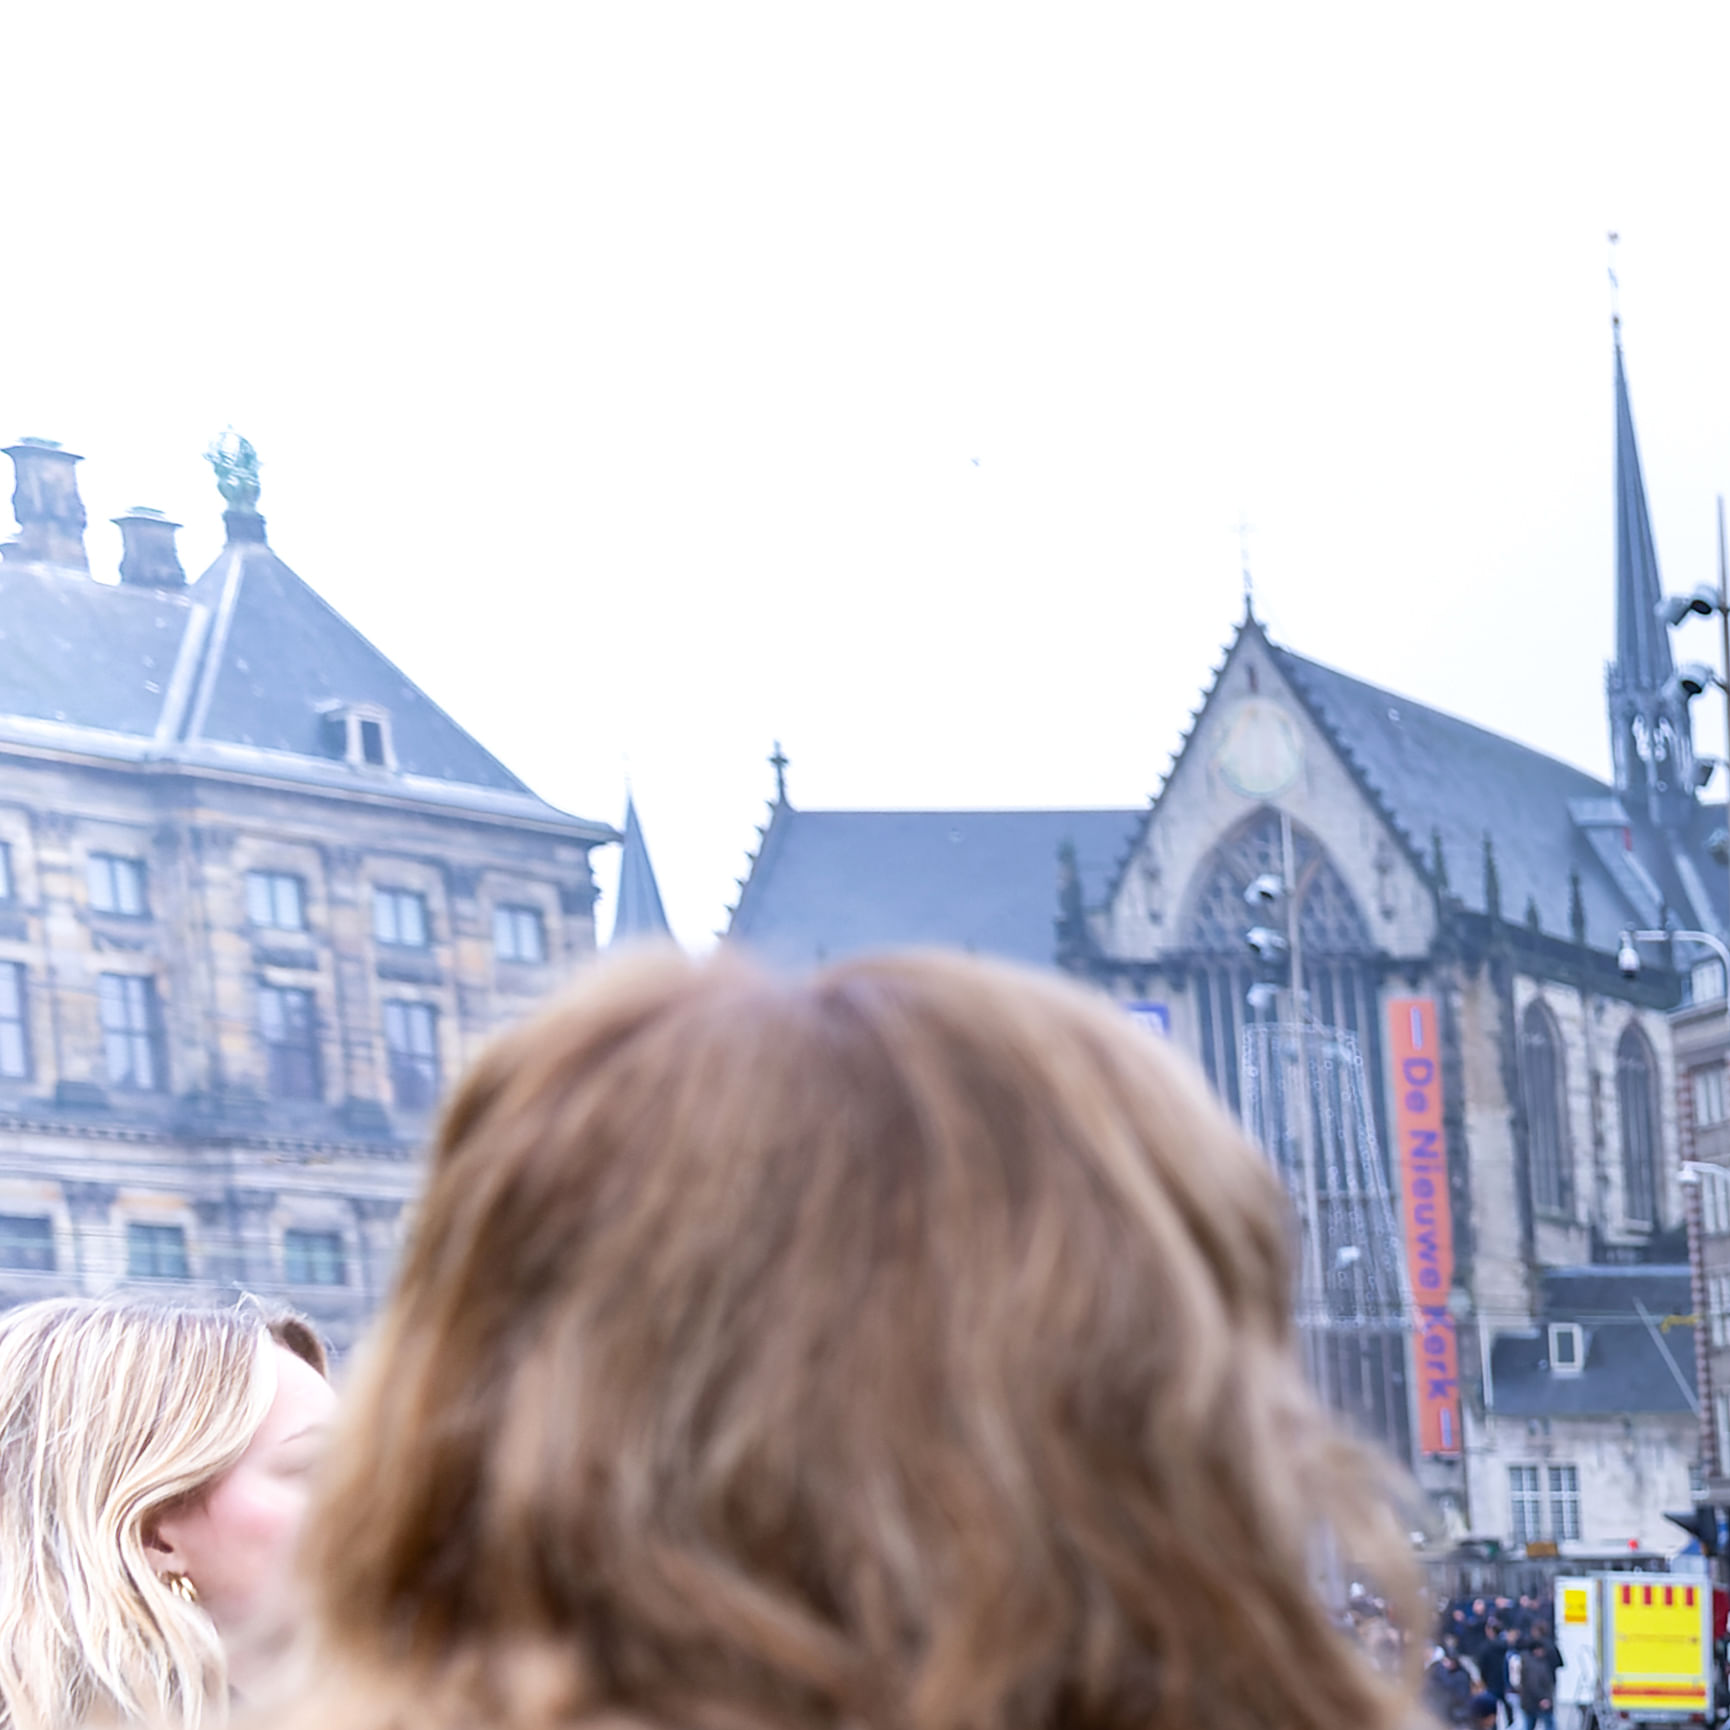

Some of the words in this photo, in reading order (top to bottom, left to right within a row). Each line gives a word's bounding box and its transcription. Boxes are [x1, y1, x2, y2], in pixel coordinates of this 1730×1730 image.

[1403, 1057, 1434, 1114] De
[1409, 1129, 1444, 1289] Nieuwe
[1422, 1305, 1458, 1399] Kerk
